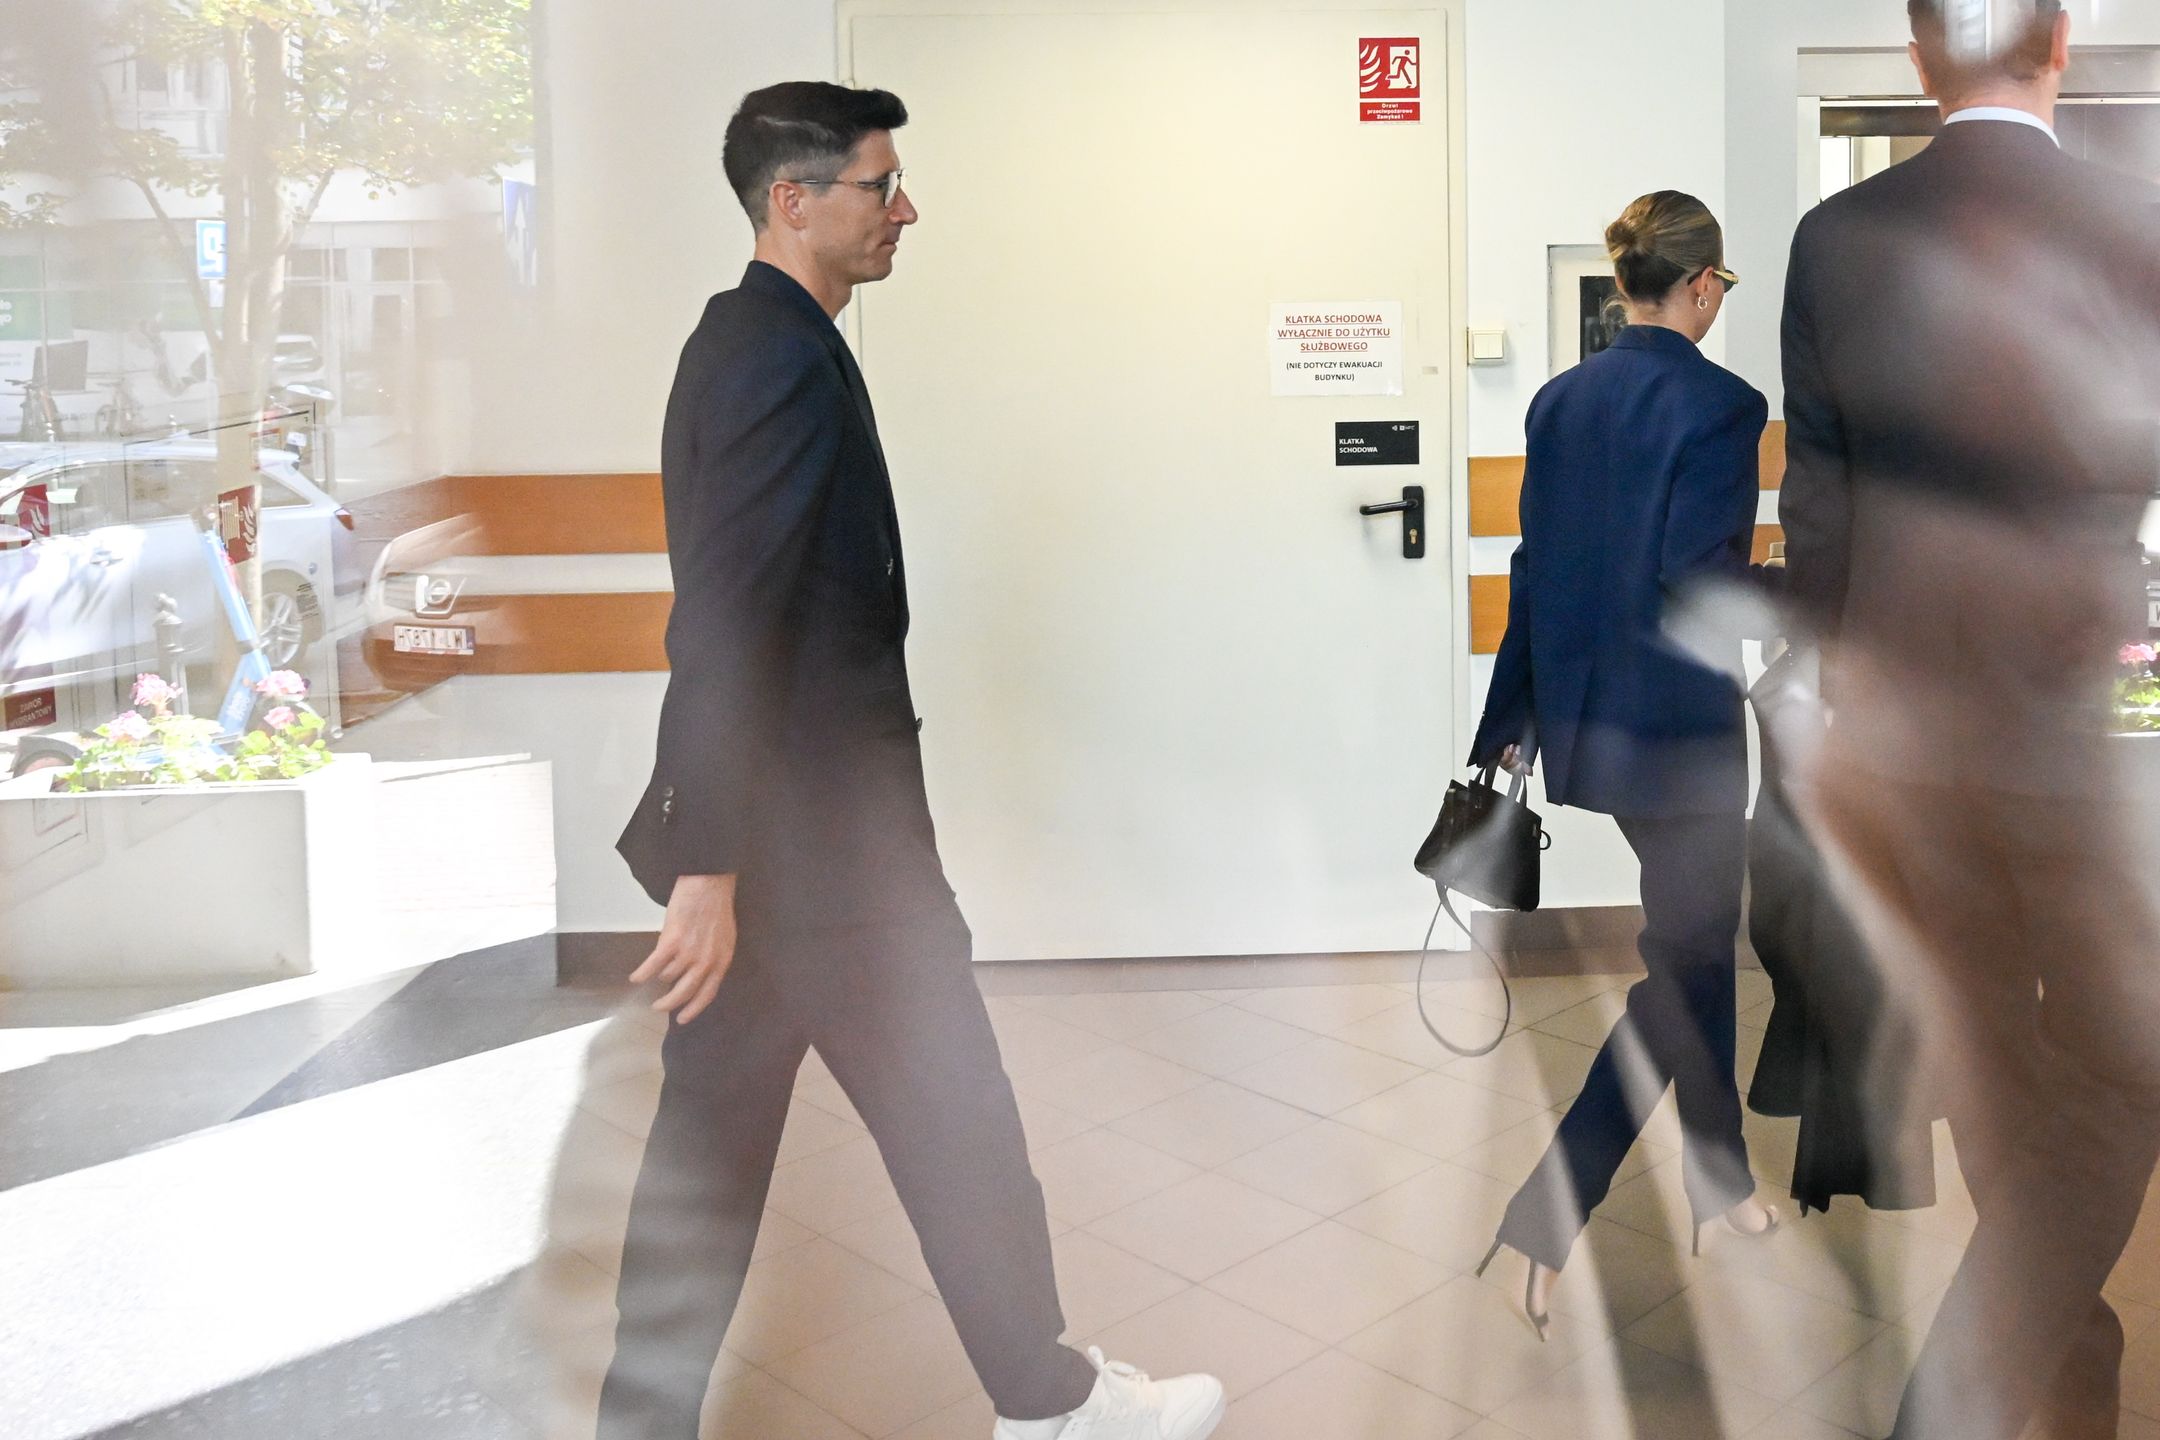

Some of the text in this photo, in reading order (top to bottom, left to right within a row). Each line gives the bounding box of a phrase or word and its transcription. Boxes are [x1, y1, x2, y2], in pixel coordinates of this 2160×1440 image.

[1285, 314, 1383, 324] KLATKA SCHODOWA
[1277, 326, 1391, 338] WYŁĄCZNIE DO UŻYTKU
[1300, 340, 1368, 351] SŁUŻBOWEGO
[1286, 361, 1383, 371] (NIE DOTYCZY EWAKUACJI
[1314, 373, 1355, 381] BUDYNKU)
[1339, 446, 1378, 454] SCHODOWA
